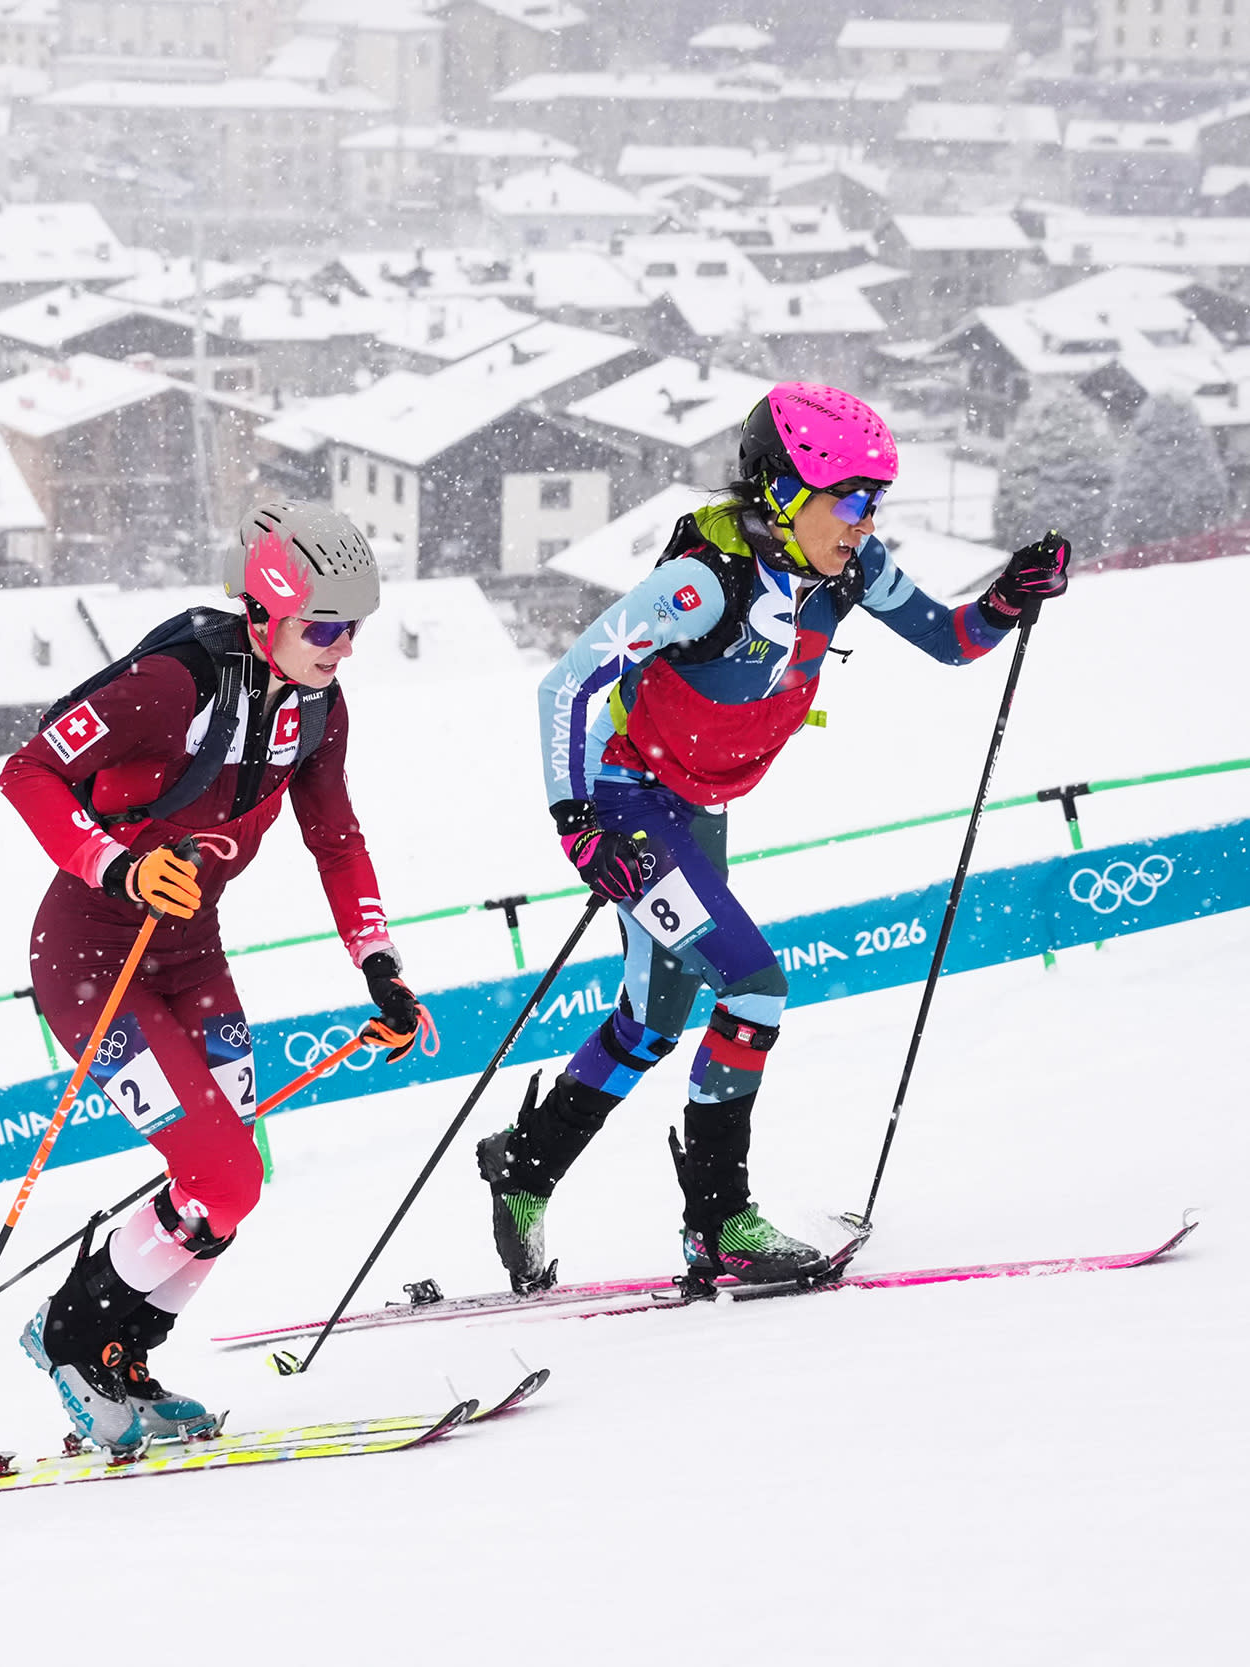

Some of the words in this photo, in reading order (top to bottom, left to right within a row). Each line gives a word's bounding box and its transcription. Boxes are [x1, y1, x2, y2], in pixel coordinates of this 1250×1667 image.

[785, 394, 844, 421] DYNAFIT
[302, 690, 324, 703] MILLET
[551, 671, 579, 782] SLOVAKIA
[651, 898, 681, 932] 8
[854, 918, 926, 956] 2026
[120, 1079, 151, 1116] 2
[238, 1066, 254, 1105] 2
